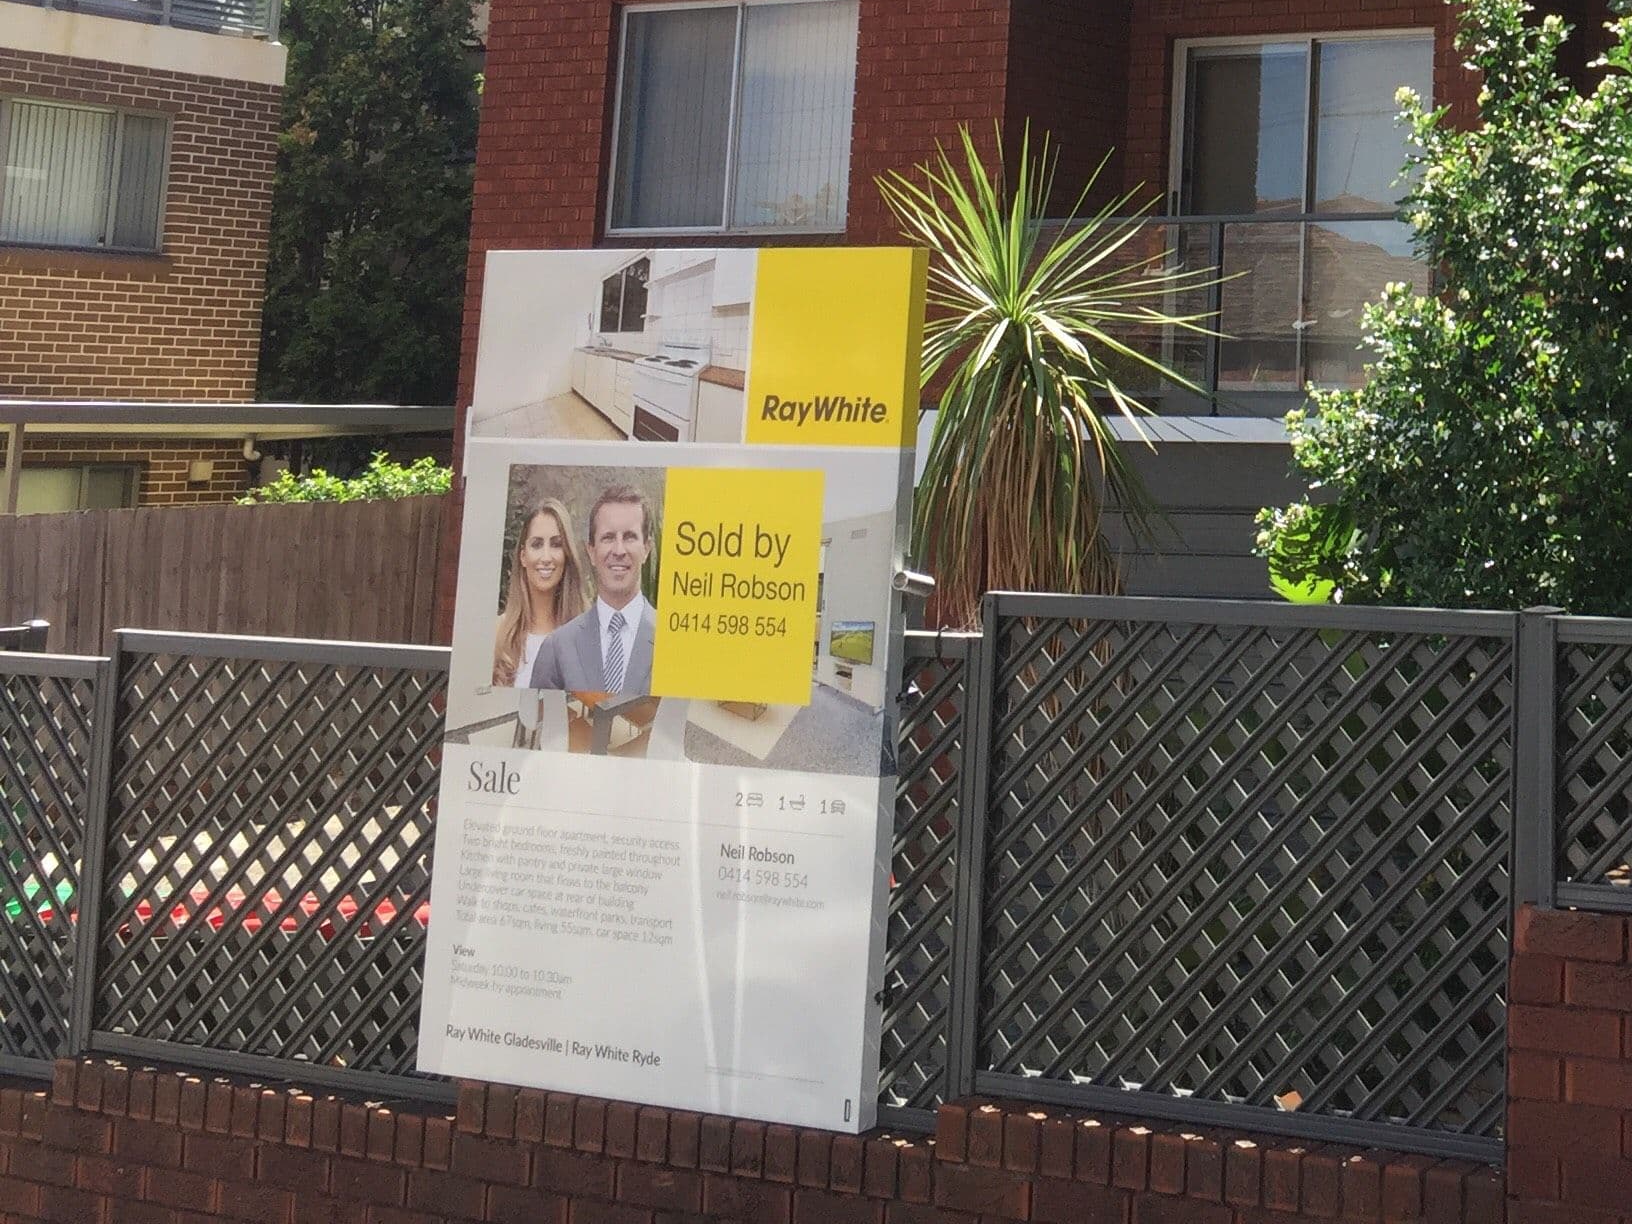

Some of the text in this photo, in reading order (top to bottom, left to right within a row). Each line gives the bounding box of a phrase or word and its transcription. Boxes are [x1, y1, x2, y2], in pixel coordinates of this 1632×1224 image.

[675, 521, 792, 568] Sold by
[672, 571, 806, 601] Neil Robson
[669, 612, 787, 637] 0414 598 554
[467, 760, 521, 795] Sale
[735, 792, 828, 814] 2 1 1
[629, 851, 681, 868] throughout
[721, 843, 795, 864] Neil Robson
[719, 866, 808, 889] 0414 598 554
[630, 914, 673, 930] transport
[452, 943, 475, 957] View
[446, 1024, 466, 1042] Ray
[468, 1026, 502, 1045] White
[503, 1032, 563, 1053] Gladesville
[572, 1041, 593, 1060] Ray
[595, 1044, 630, 1063] White
[632, 1049, 661, 1068] Ryde
